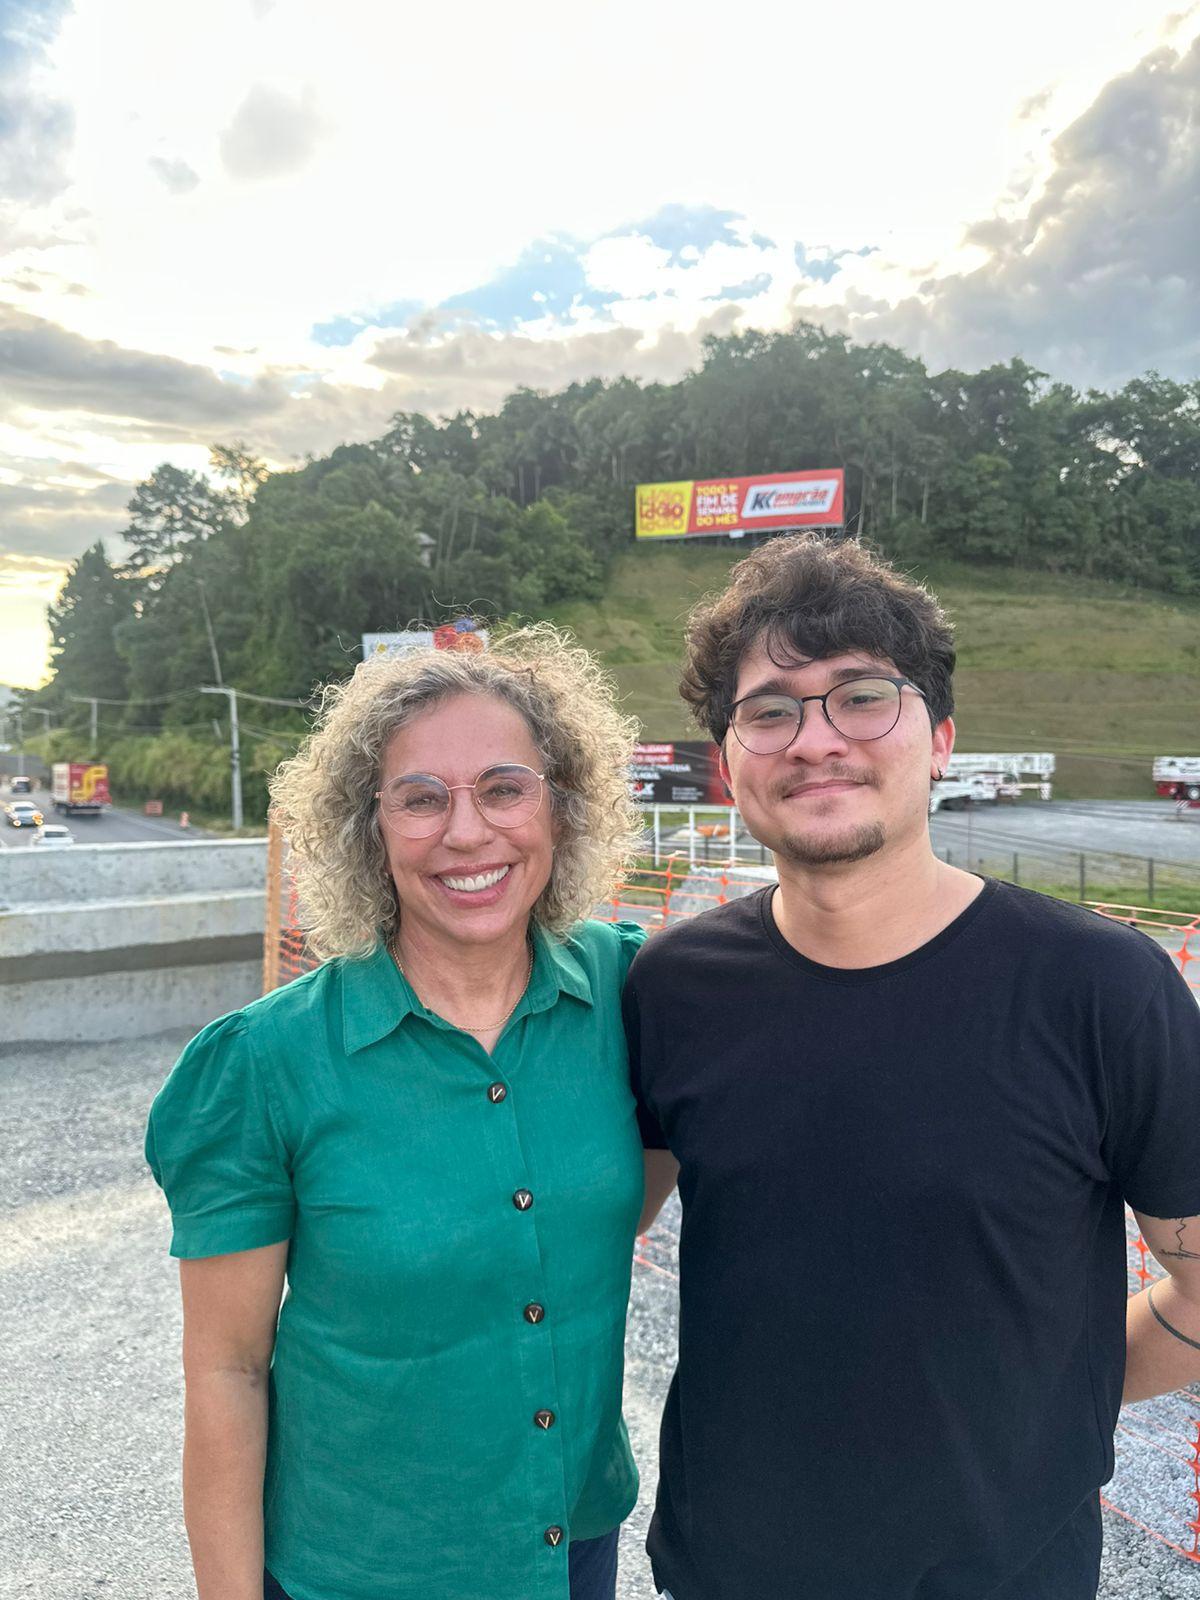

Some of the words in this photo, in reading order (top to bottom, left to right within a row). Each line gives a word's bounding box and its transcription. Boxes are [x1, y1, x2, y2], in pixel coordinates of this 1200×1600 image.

[696, 485, 727, 497] TODO
[696, 495, 718, 506] FIM
[720, 493, 738, 505] DE
[696, 505, 738, 516] SEMANA
[696, 515, 714, 527] DO
[716, 513, 738, 525] MÊS
